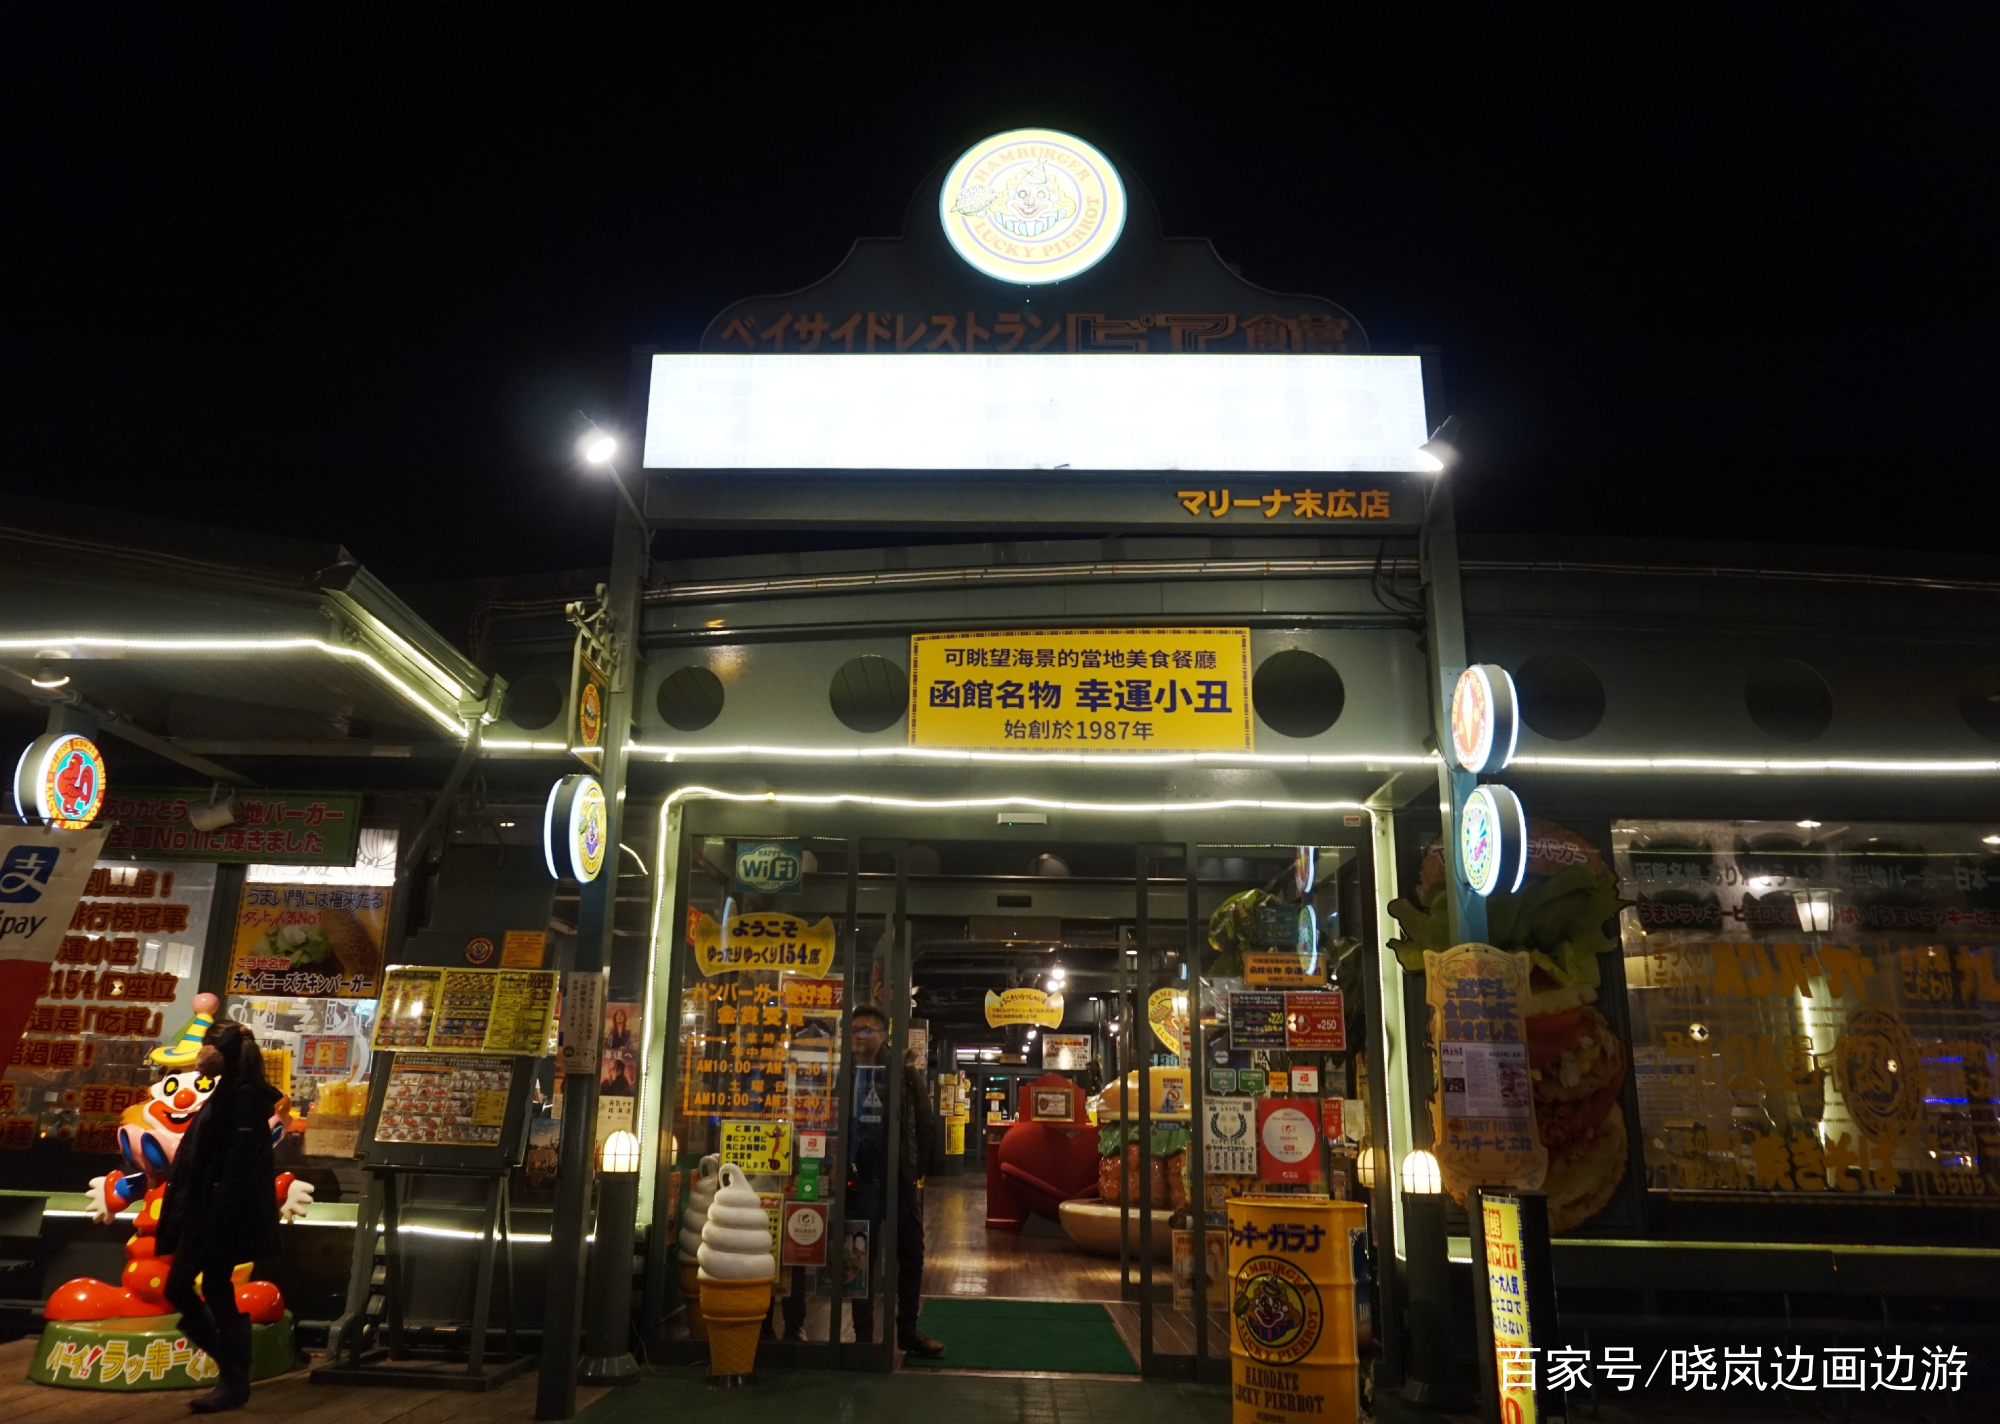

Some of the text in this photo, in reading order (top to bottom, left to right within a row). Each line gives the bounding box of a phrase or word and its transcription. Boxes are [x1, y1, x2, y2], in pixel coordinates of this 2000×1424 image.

[974, 146, 1090, 182] HAMBURGER
[974, 196, 1099, 258] LUCKY PIERROT
[1177, 488, 1390, 520] マリーナ末広店
[945, 648, 1217, 670] 可眺望海景的當地美食餐廳
[929, 679, 1232, 713] 函館名物 幸運小丑
[1004, 719, 1154, 741] 始創於1987年
[732, 921, 799, 938] ようこそ
[56, 936, 139, 964] 運小丑
[236, 957, 291, 970] ご当地名物
[233, 972, 373, 993] チャイニーズチキンバーガー
[1239, 1308, 1319, 1361] LUCKY PIERROT
[1244, 1366, 1299, 1391] HAKODATE
[1264, 1390, 1325, 1414] PIERROT
